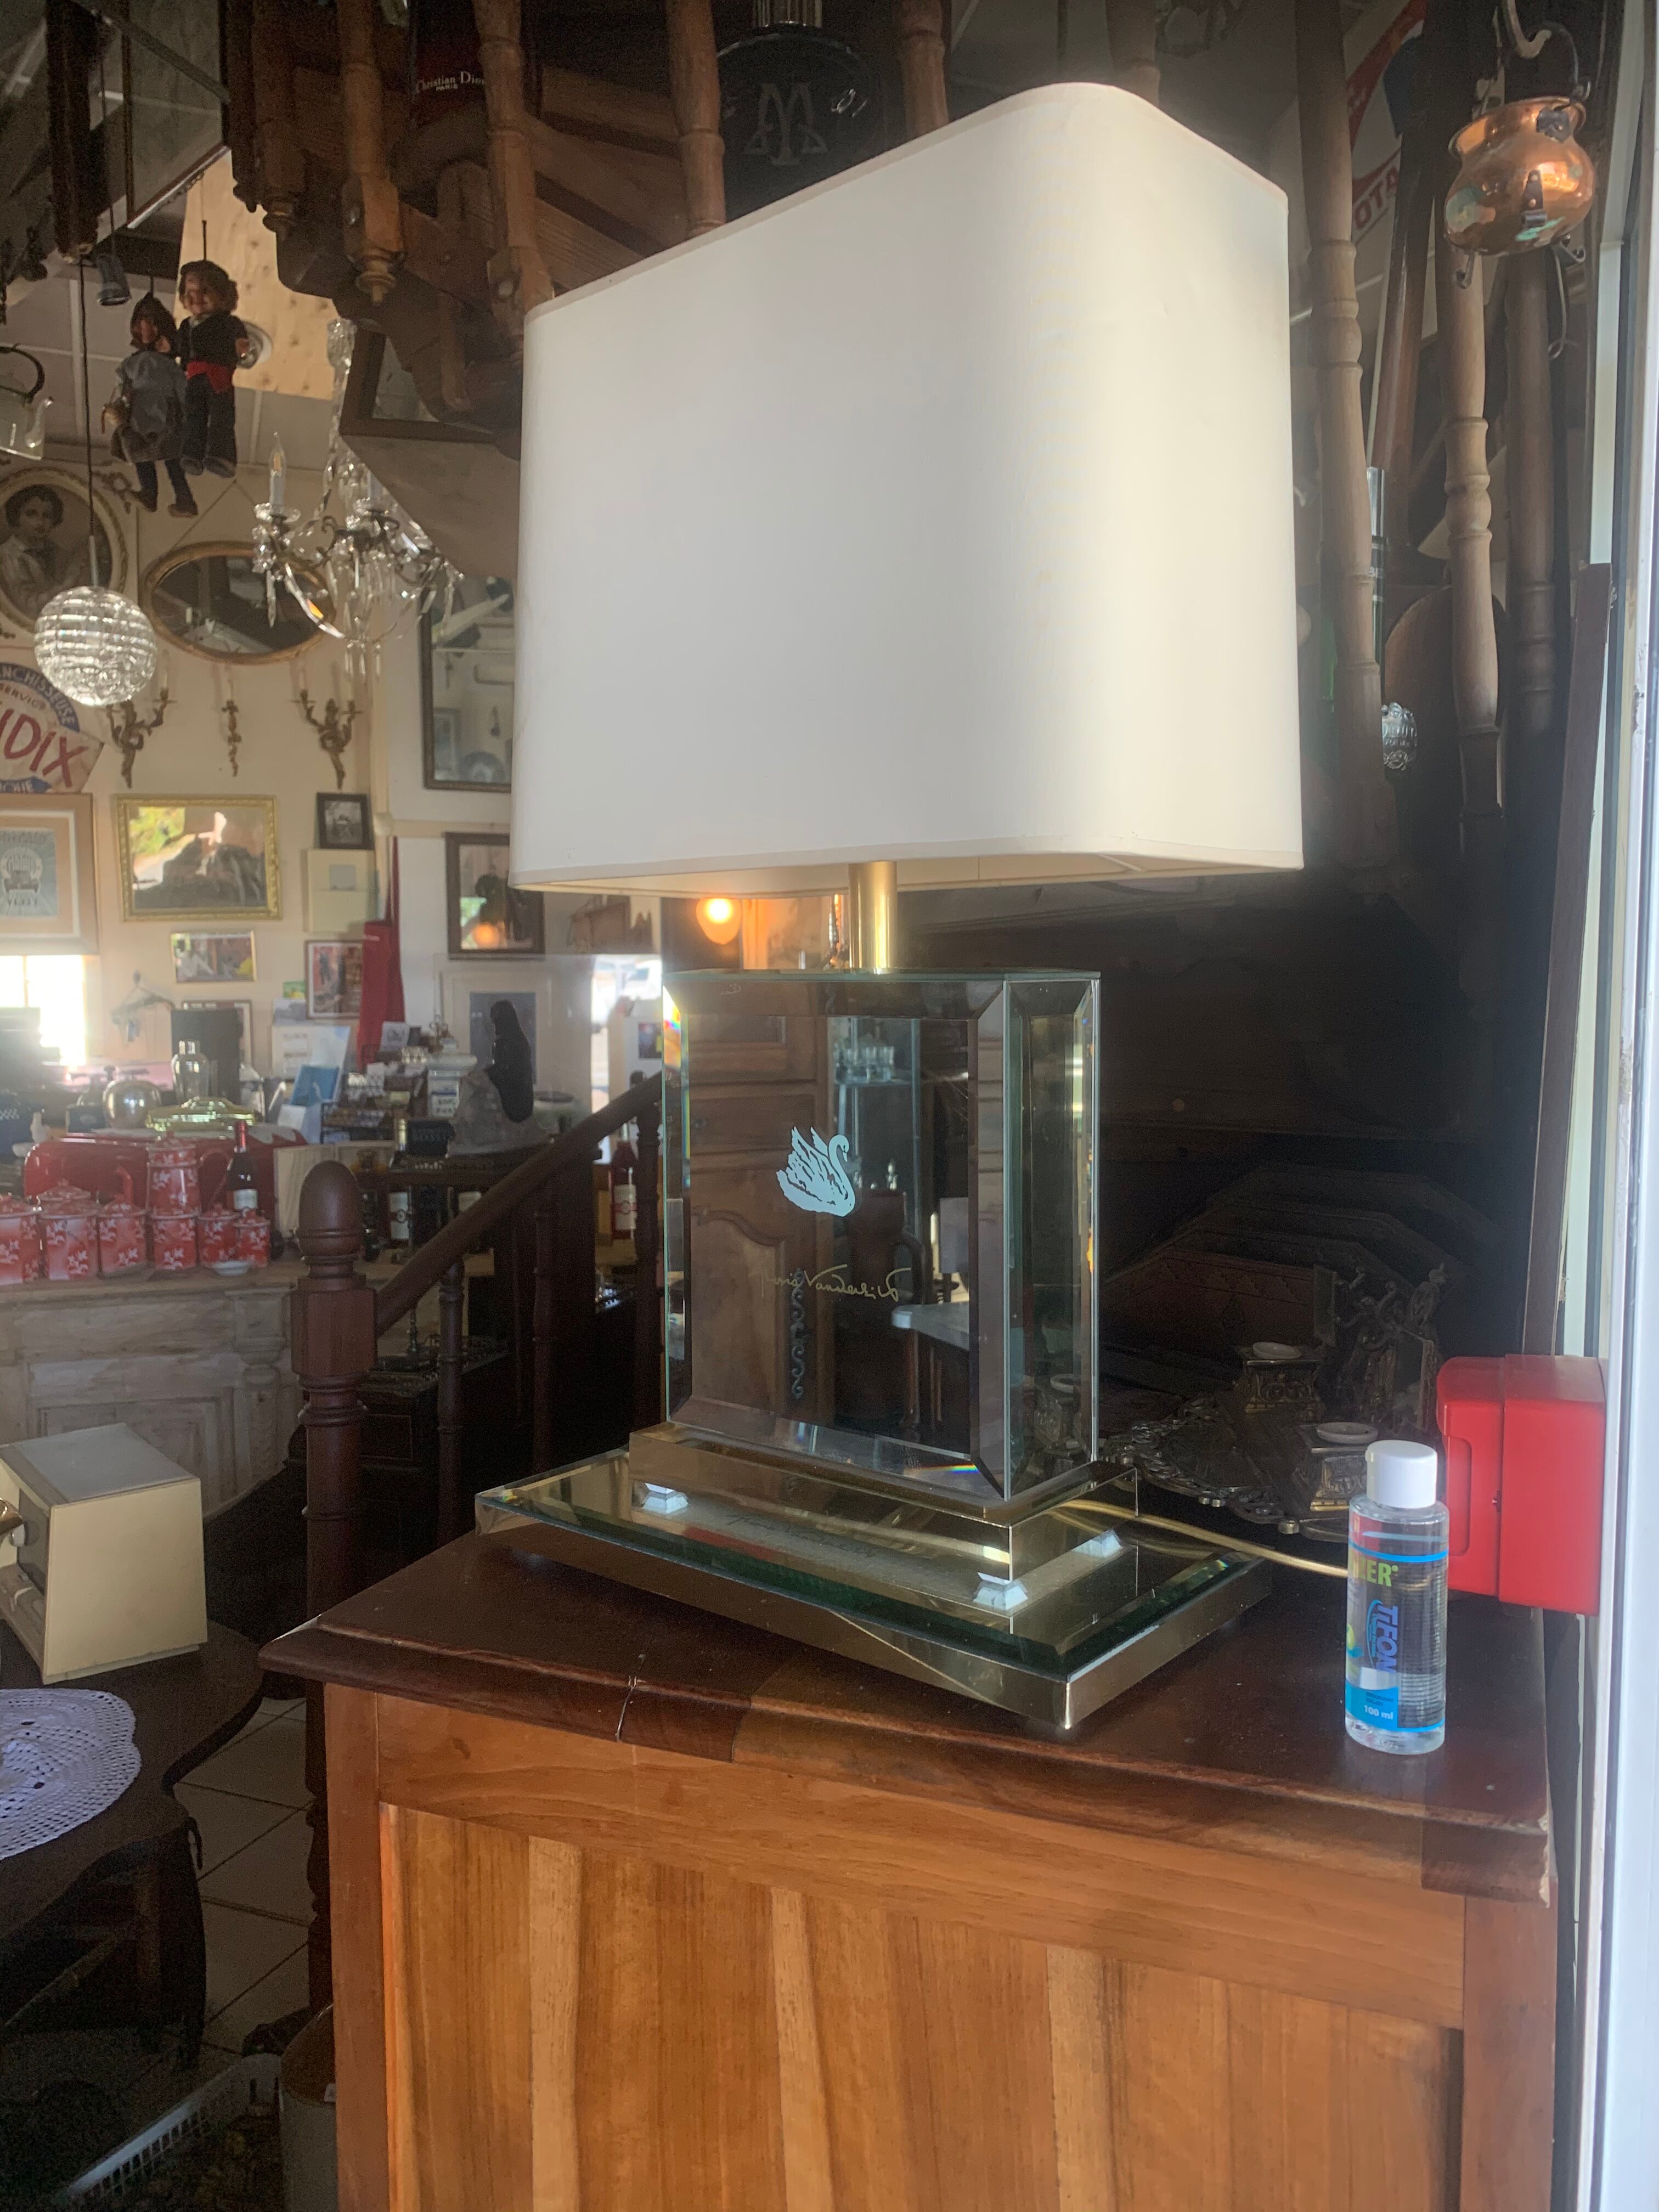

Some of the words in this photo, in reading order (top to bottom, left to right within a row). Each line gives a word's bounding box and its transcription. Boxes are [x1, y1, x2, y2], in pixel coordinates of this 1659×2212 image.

[0, 665, 76, 725] NCHISSEUSE
[1364, 1705, 1379, 1717] 100
[1381, 1711, 1393, 1720] ml
